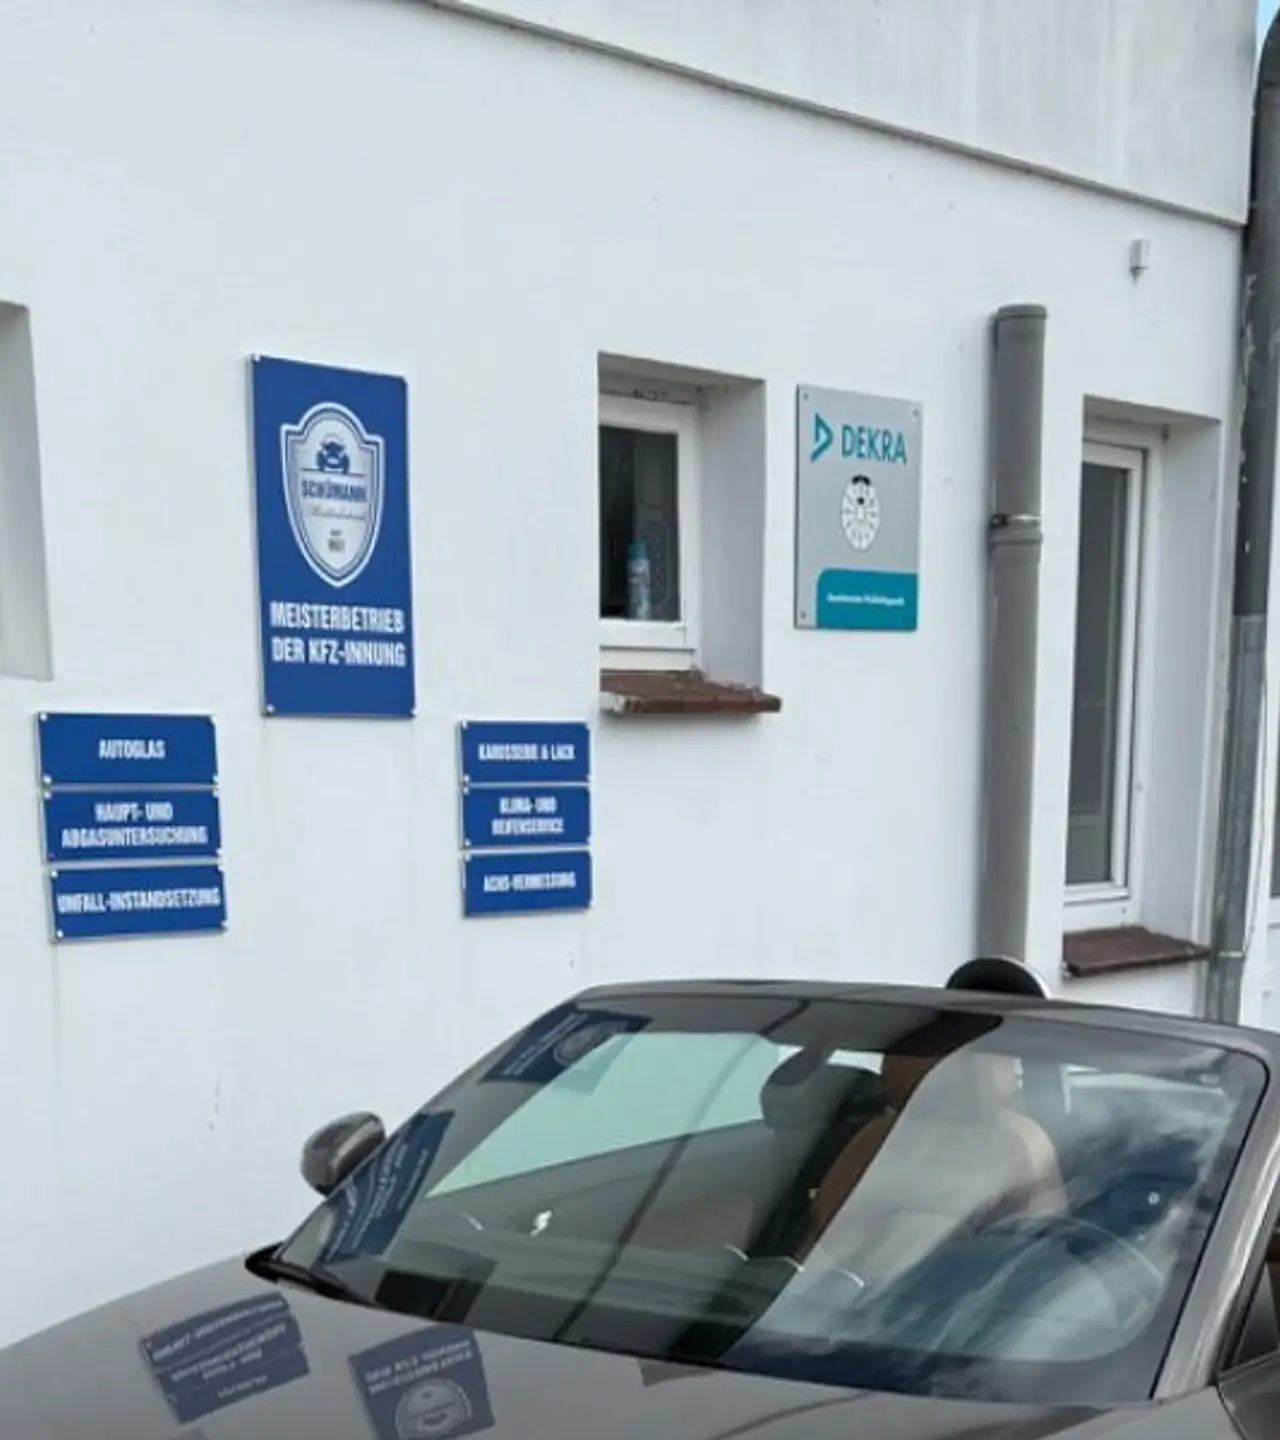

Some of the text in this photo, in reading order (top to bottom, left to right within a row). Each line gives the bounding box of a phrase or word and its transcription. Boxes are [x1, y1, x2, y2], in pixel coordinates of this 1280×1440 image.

[841, 424, 908, 466] DEKRA
[270, 601, 405, 633] MEISTERBETRIEB
[271, 637, 407, 667] DER KFZ-INNUNG
[98, 739, 166, 759] AUTOGLAS
[145, 801, 174, 821] UND
